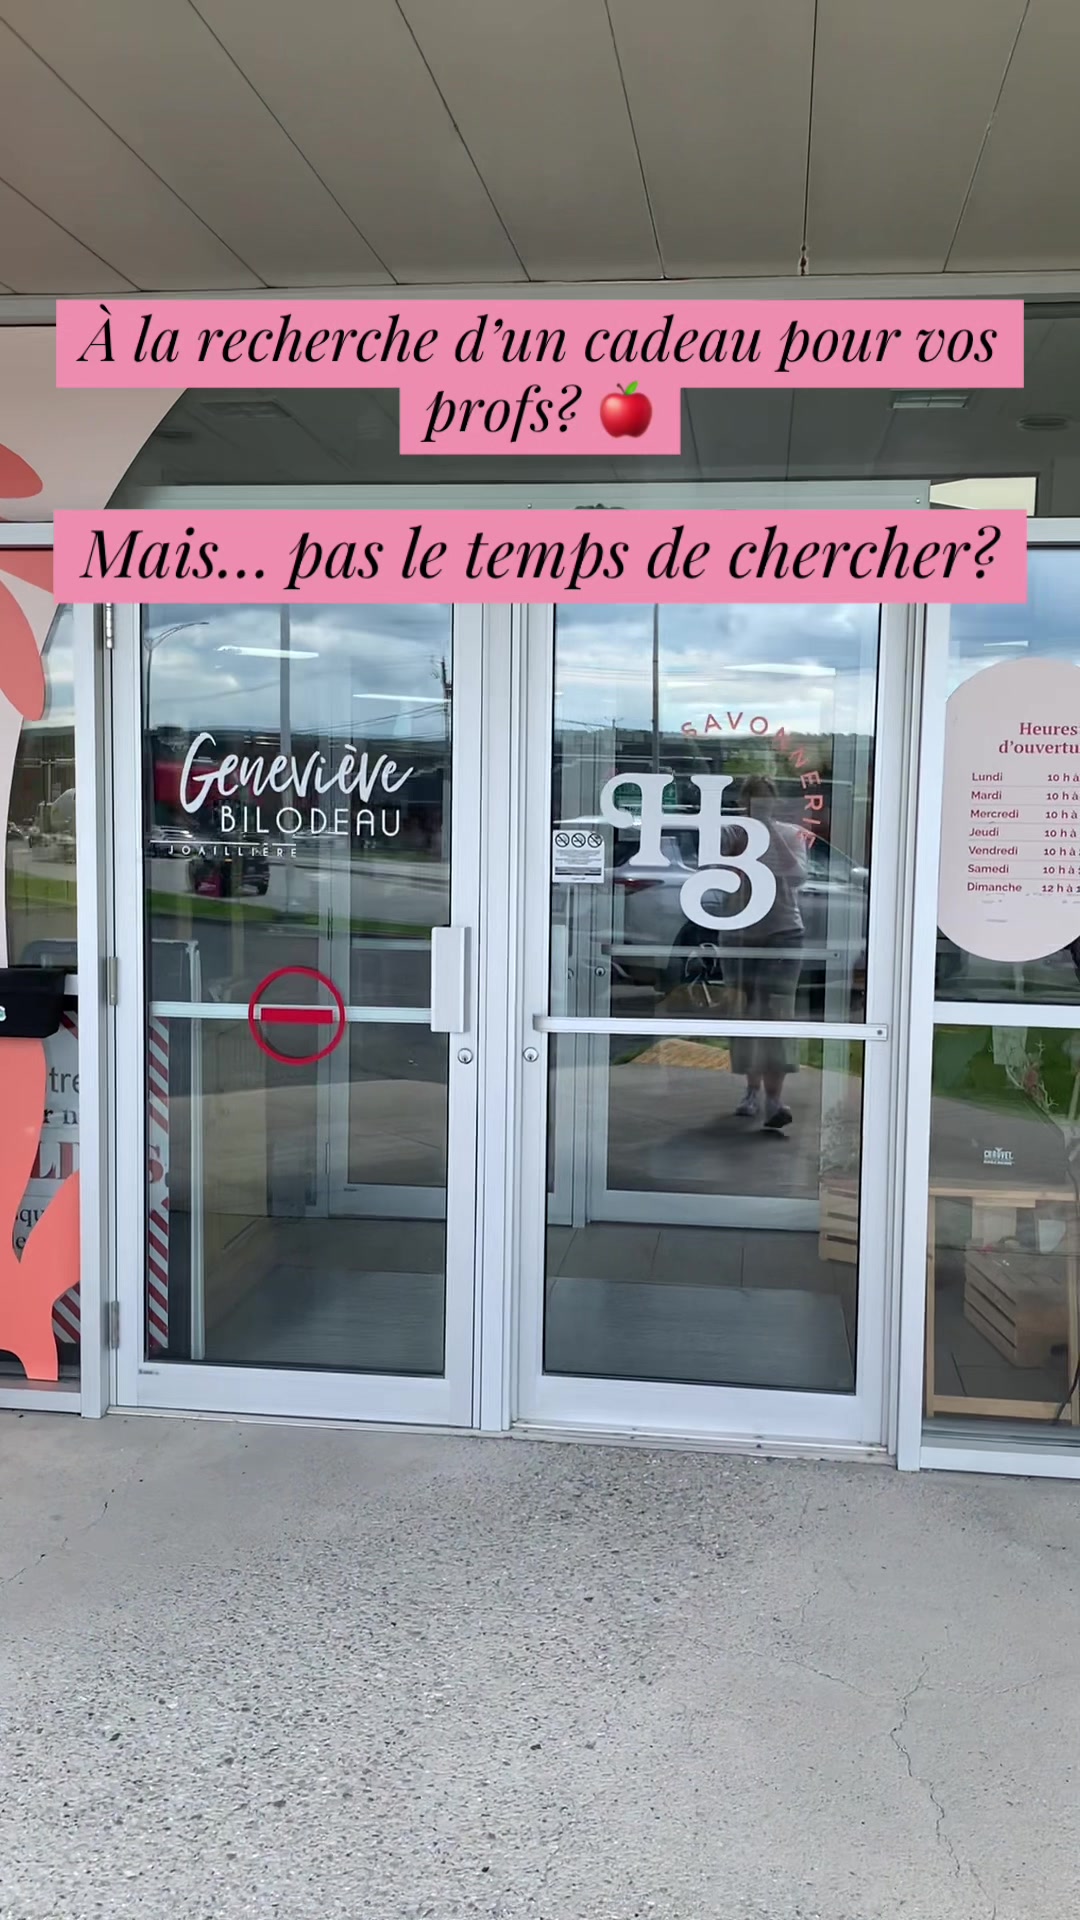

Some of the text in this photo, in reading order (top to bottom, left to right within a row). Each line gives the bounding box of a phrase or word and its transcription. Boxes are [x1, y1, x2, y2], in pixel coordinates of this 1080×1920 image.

[1019, 722, 1078, 736] Heures
[180, 732, 414, 814] Geneviève
[972, 772, 1080, 782] Lundi 10 h à
[681, 711, 824, 849] SAVONNERIE
[971, 791, 1002, 800] Mardi
[1062, 792, 1069, 800] h
[1072, 792, 1078, 800] à
[970, 809, 1078, 819] Mercredi 10 h à
[221, 805, 400, 836] BILODEAU
[969, 827, 1077, 838] Jeudi 10 h à
[168, 842, 297, 858] JOAILLIÈRE
[968, 846, 1076, 856] Vendredi 10 h à
[968, 864, 1009, 873] Samedi
[1059, 866, 1065, 874] h
[1068, 866, 1075, 874] à
[967, 882, 1022, 892] Dimanche
[1042, 885, 1054, 893] 12
[1057, 884, 1064, 893] h
[1066, 884, 1073, 893] à
